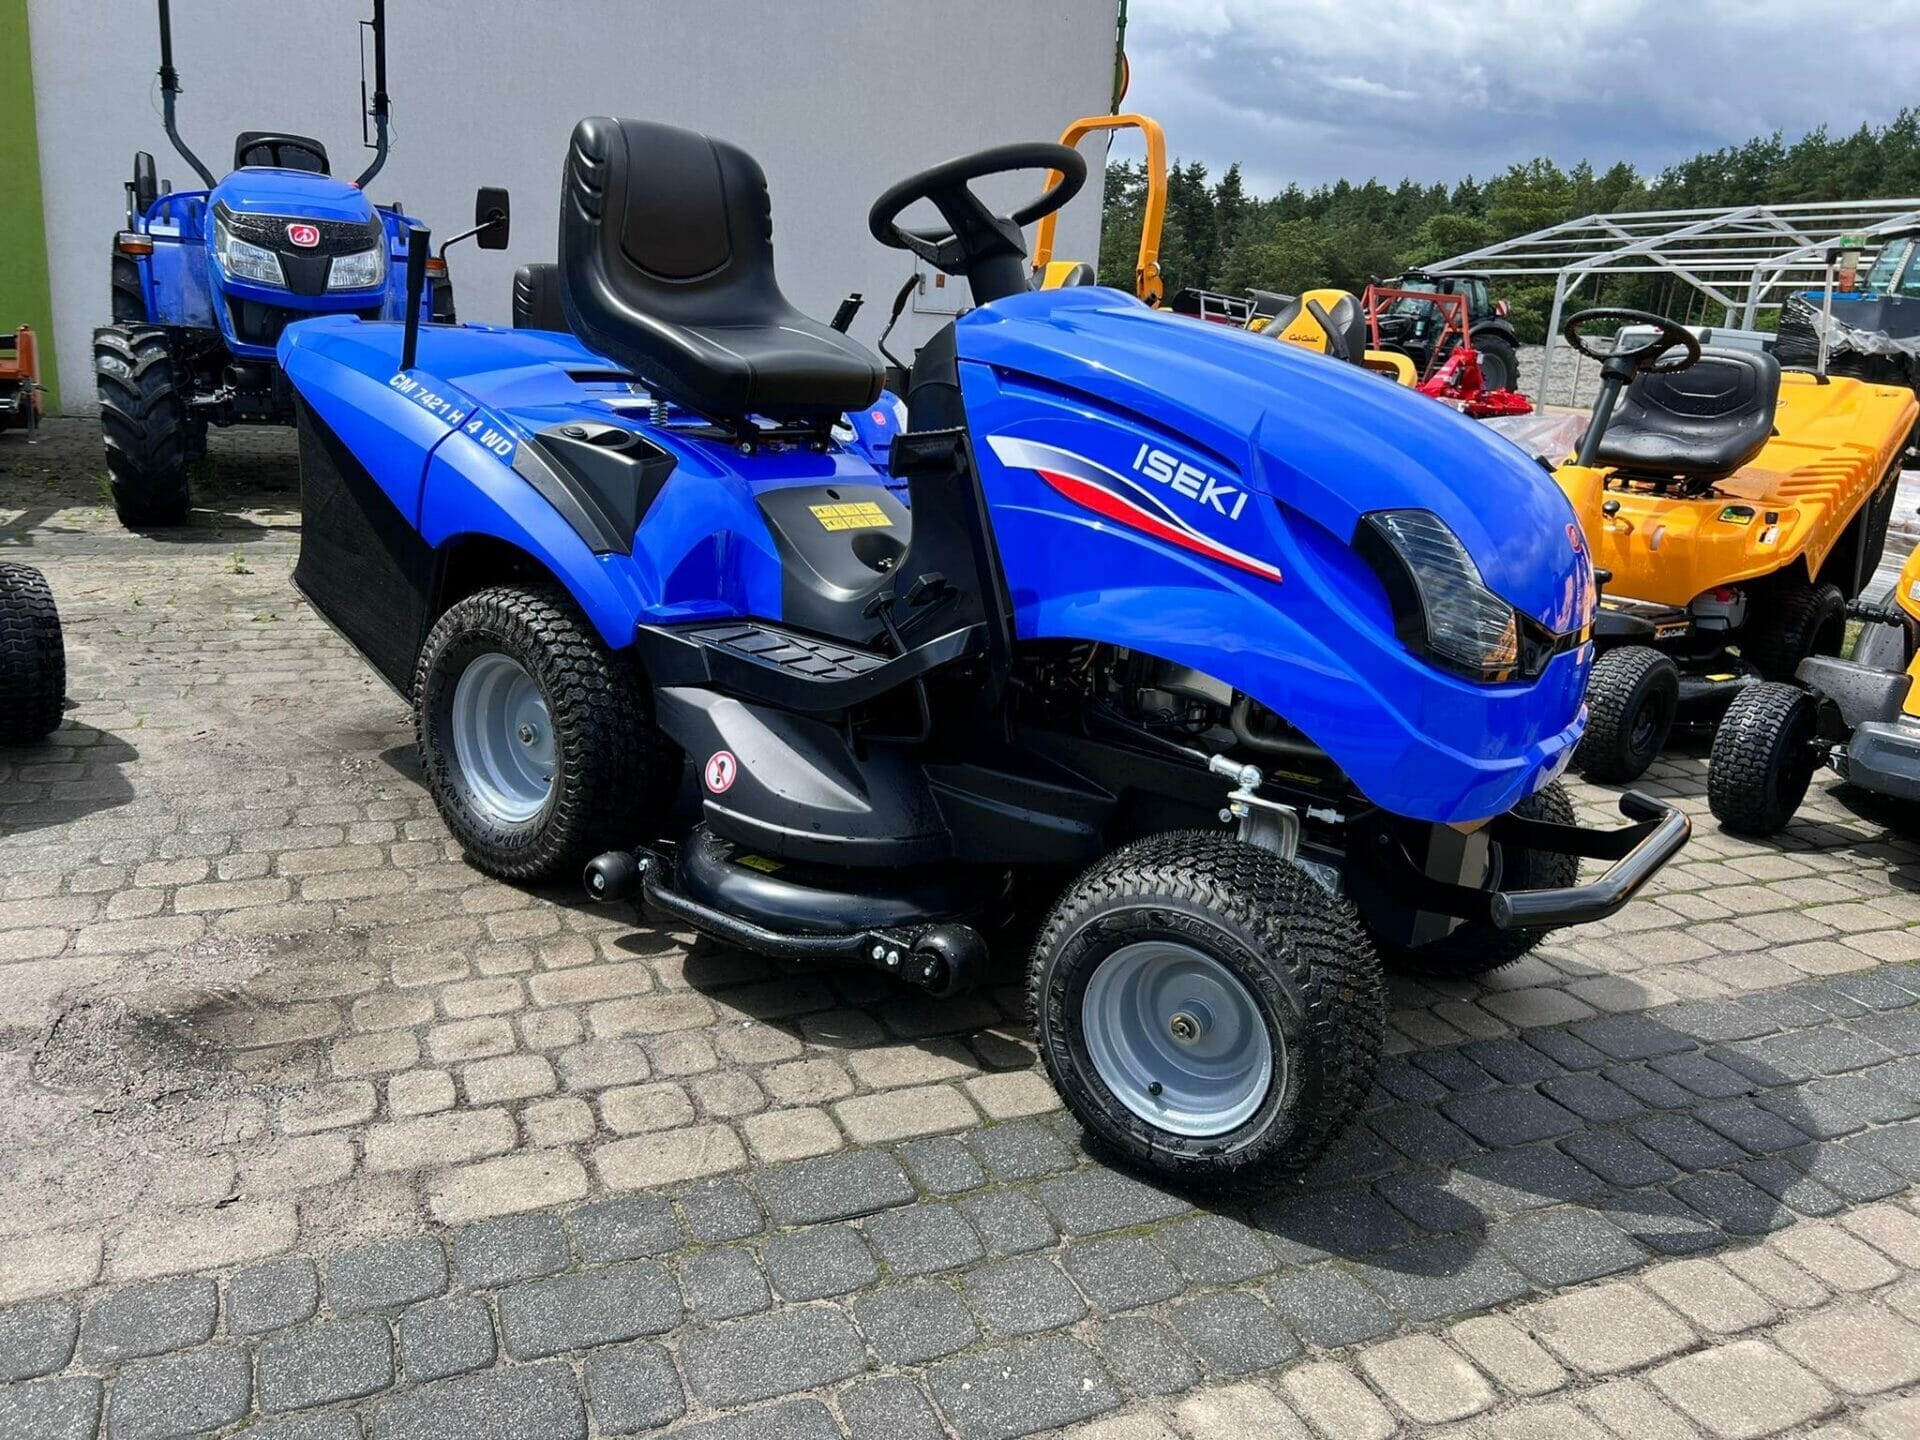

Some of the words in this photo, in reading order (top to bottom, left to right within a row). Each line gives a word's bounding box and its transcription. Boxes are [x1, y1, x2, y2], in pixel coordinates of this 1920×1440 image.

[389, 373, 419, 393] CM
[413, 387, 451, 415] 7421
[446, 409, 465, 424] H
[466, 420, 484, 434] 4
[480, 428, 513, 456] WD
[1132, 442, 1249, 521] ISEKI
